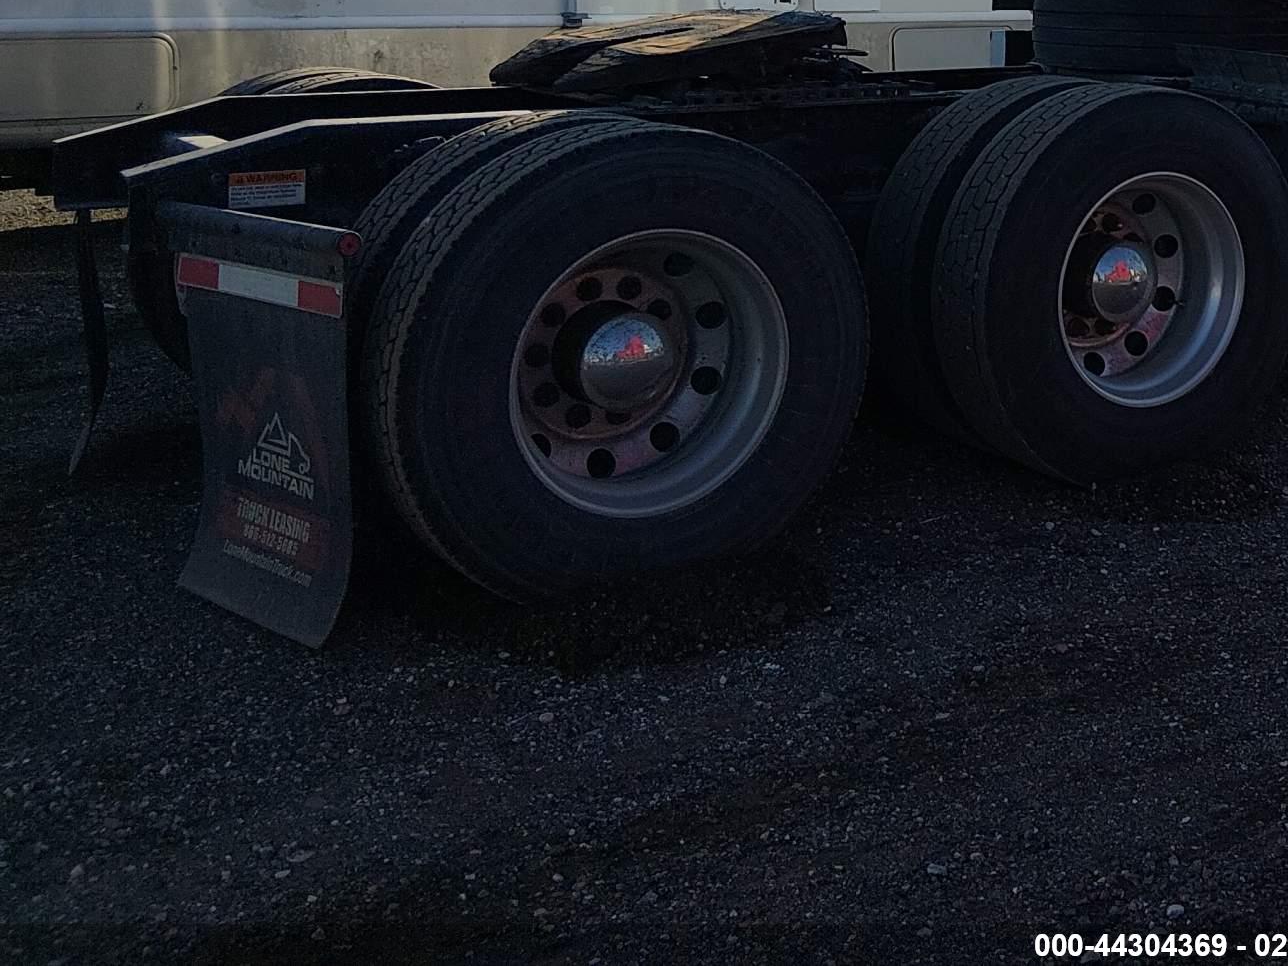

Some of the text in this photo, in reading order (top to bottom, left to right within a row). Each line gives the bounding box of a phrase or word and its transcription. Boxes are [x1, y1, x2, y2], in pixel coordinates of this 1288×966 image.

[247, 172, 297, 183] WARNING
[253, 447, 291, 471] LONE
[237, 453, 315, 501] MOUNTAIN
[269, 509, 311, 545] LEASING
